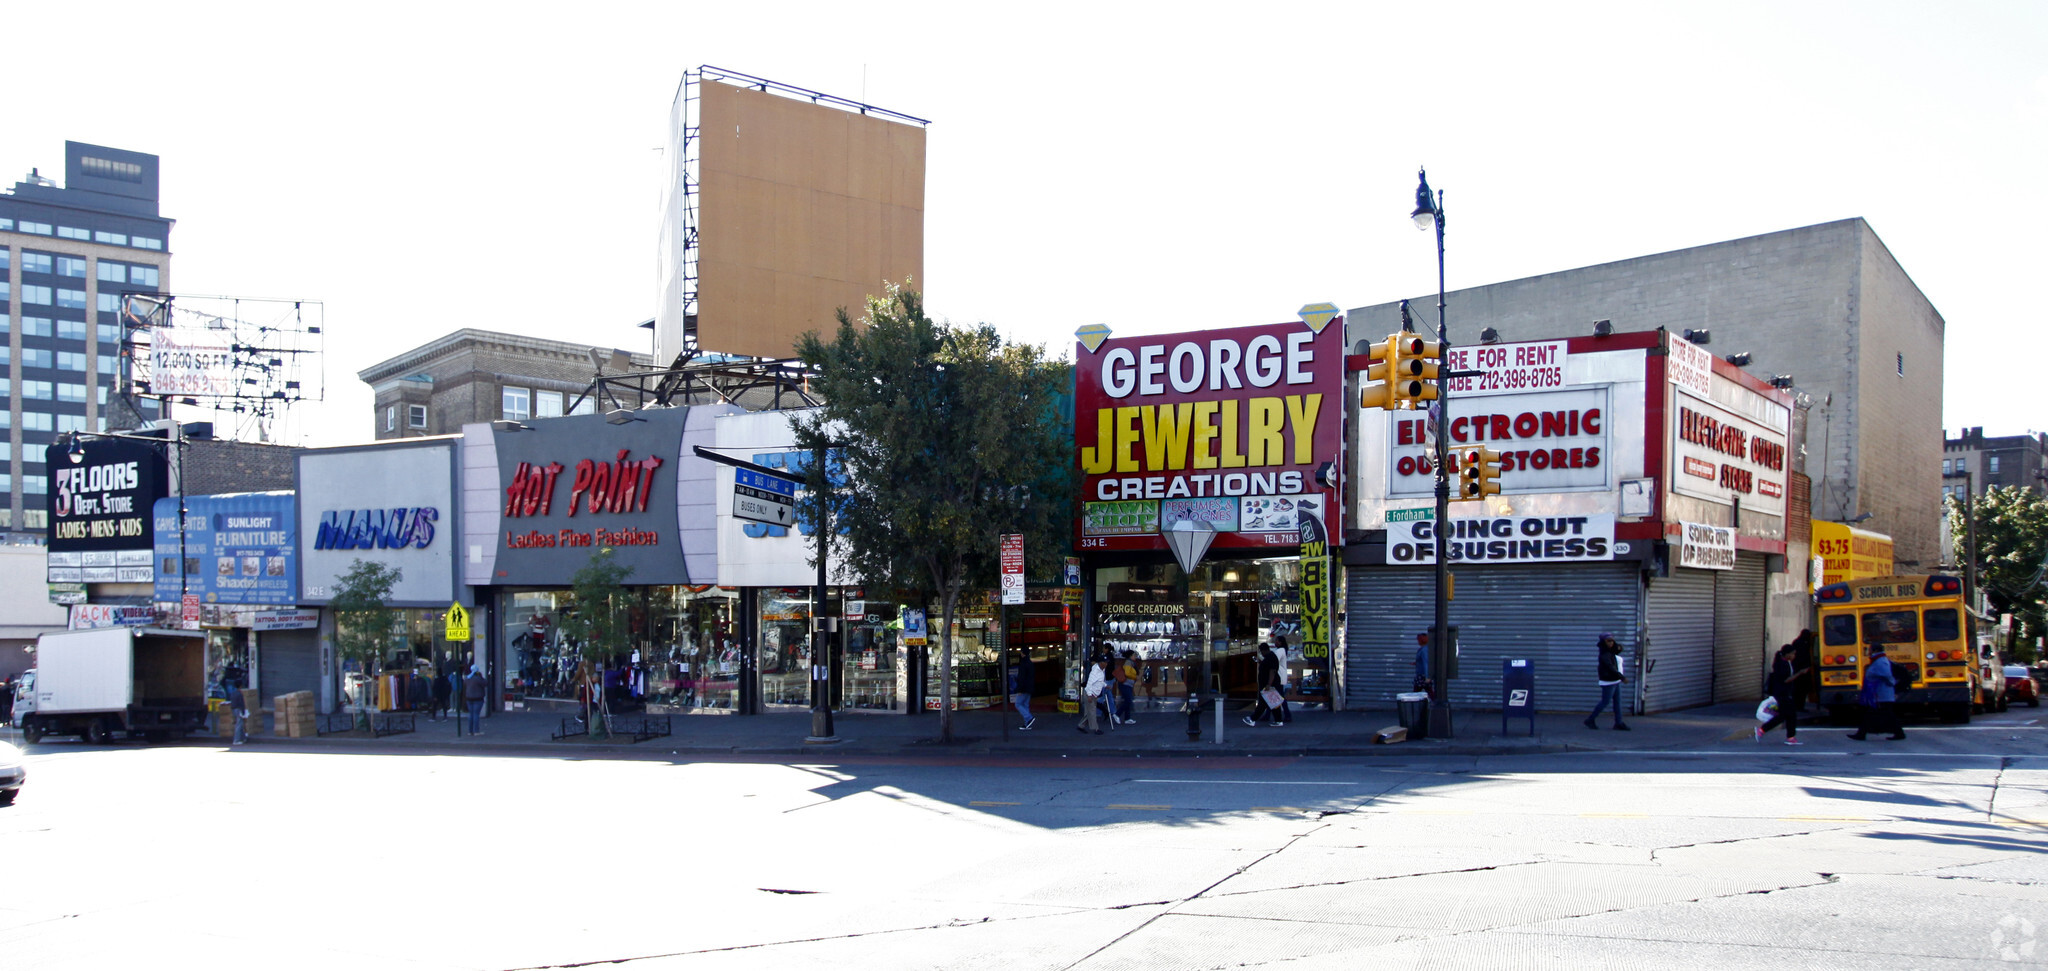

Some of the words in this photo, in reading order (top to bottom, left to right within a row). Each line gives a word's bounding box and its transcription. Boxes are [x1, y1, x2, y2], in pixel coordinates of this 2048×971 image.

[1477, 347, 1507, 369] FOR
[1516, 344, 1557, 367] RENT
[1101, 331, 1314, 398] GEORGE
[1480, 366, 1561, 390] 212-398-8785
[1081, 392, 1323, 475] JEWELRY
[1397, 408, 1601, 446] ELCTRONIC
[1680, 406, 1747, 459] ELECTRONIC
[1750, 434, 1785, 472] OUTLET
[56, 468, 71, 517] 3
[70, 461, 138, 494] FLOORS
[504, 461, 565, 518] HOT
[754, 475, 764, 487] BUS
[767, 478, 779, 490] LANE
[1097, 470, 1303, 501] CREATIONS
[741, 500, 756, 513] BUSES
[756, 504, 767, 515] ONLY
[1090, 501, 1156, 515] PAWN
[1165, 499, 1222, 512] PERFUMES
[1225, 499, 1234, 509] &
[227, 517, 272, 528] SUNLIGHT
[1089, 514, 1156, 526] SHOP
[1166, 511, 1233, 522] COLOGNES
[1386, 511, 1390, 522] E
[1393, 509, 1425, 521] Fordham
[56, 521, 86, 539] LADIES
[90, 519, 115, 538] MENS
[120, 518, 142, 536] KIDS
[314, 507, 439, 550] MANUS
[1411, 519, 1512, 540] GOING
[1520, 517, 1588, 536] OUT
[1688, 524, 1714, 545] GOING
[1715, 530, 1729, 547] OUT
[215, 531, 287, 546] FURNITURE
[506, 530, 555, 548] Ladies
[558, 528, 591, 547] Fine
[594, 526, 658, 546] Fashion
[1082, 539, 1096, 547] 334
[1099, 538, 1108, 546] E.
[1264, 535, 1280, 544] TEL.
[1392, 543, 1434, 562] OF
[1449, 537, 1607, 561] BUSINESS
[121, 570, 149, 580] TATTOO
[307, 586, 318, 596] 342
[1859, 586, 1894, 599] SCHOOL
[1897, 583, 1916, 597] BUS
[74, 606, 111, 621] JACK
[1102, 604, 1135, 613] GEORGE
[1137, 604, 1184, 614] CREATIONS
[1271, 604, 1283, 613] WE
[1285, 604, 1299, 613] BUY
[864, 614, 880, 623] UGG
